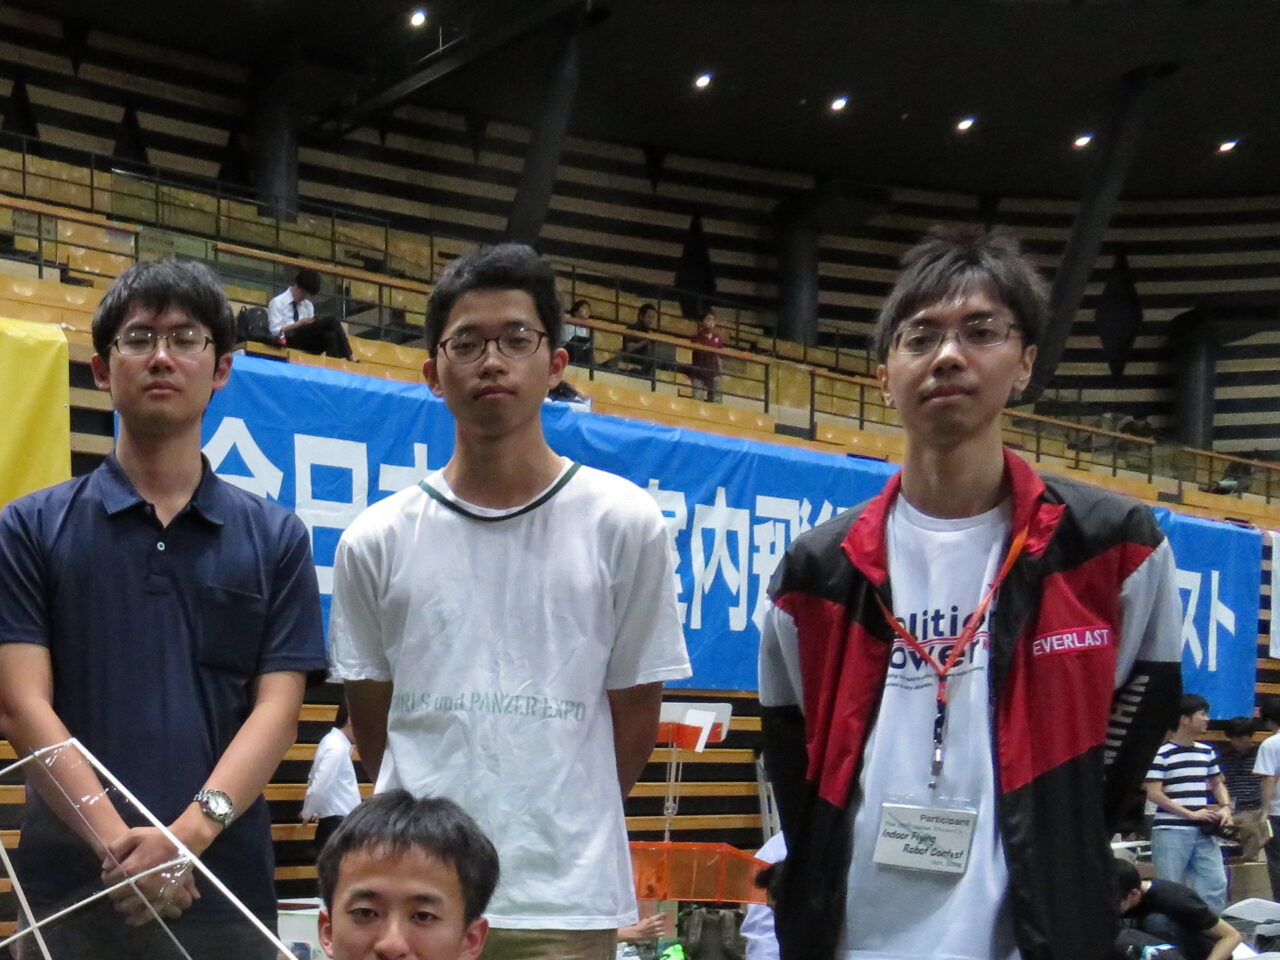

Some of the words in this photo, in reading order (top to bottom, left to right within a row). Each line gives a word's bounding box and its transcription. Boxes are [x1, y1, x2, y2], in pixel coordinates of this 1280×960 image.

[1032, 628, 1109, 657] EVERLAST
[919, 813, 971, 827] Participant
[882, 828, 909, 840] Indoor
[910, 830, 937, 846] Flying
[902, 843, 929, 856] Robot
[930, 846, 964, 859] Contest
